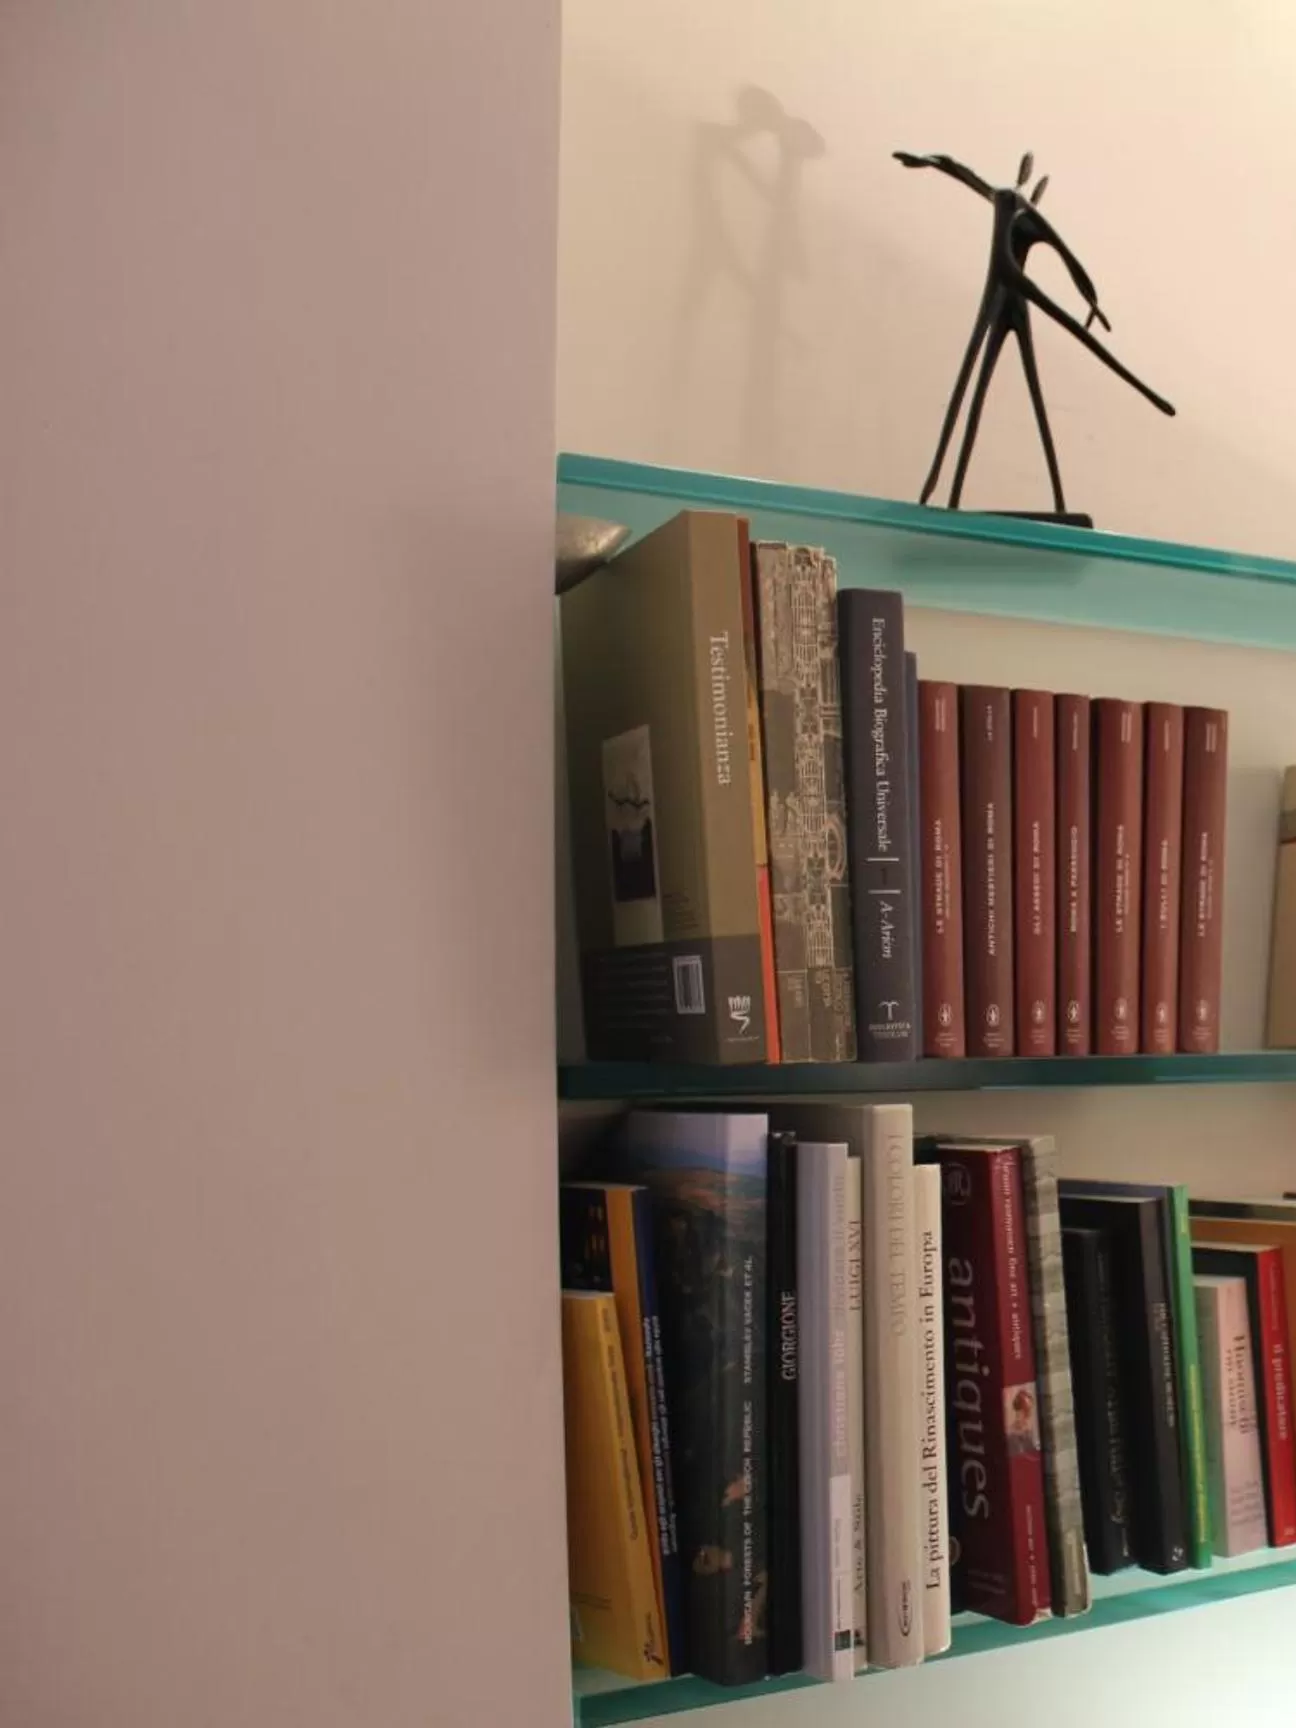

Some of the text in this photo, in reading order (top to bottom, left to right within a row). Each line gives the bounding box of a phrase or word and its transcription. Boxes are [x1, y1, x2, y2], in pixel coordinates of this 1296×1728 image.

[709, 630, 733, 787] Testimonianza
[870, 617, 892, 853] Enciclopedia Biografica Universale
[934, 819, 942, 850] ROMA
[988, 910, 996, 956] ANTICHI
[887, 1143, 905, 1220] COLORI
[847, 1219, 862, 1312] LUIGI XVI
[888, 1228, 905, 1258] DEL
[780, 1291, 798, 1381] GIORGIONE
[889, 1271, 908, 1337] TEMPO
[916, 1233, 944, 1591] La pittura del Rinascimento in Europa
[947, 1256, 991, 1520] antiques
[1270, 1357, 1288, 1440] predicatore
[743, 1401, 753, 1453] REPUBLIC
[743, 1497, 753, 1516] THE
[743, 1523, 753, 1536] OF
[743, 1538, 753, 1585] FORESTS
